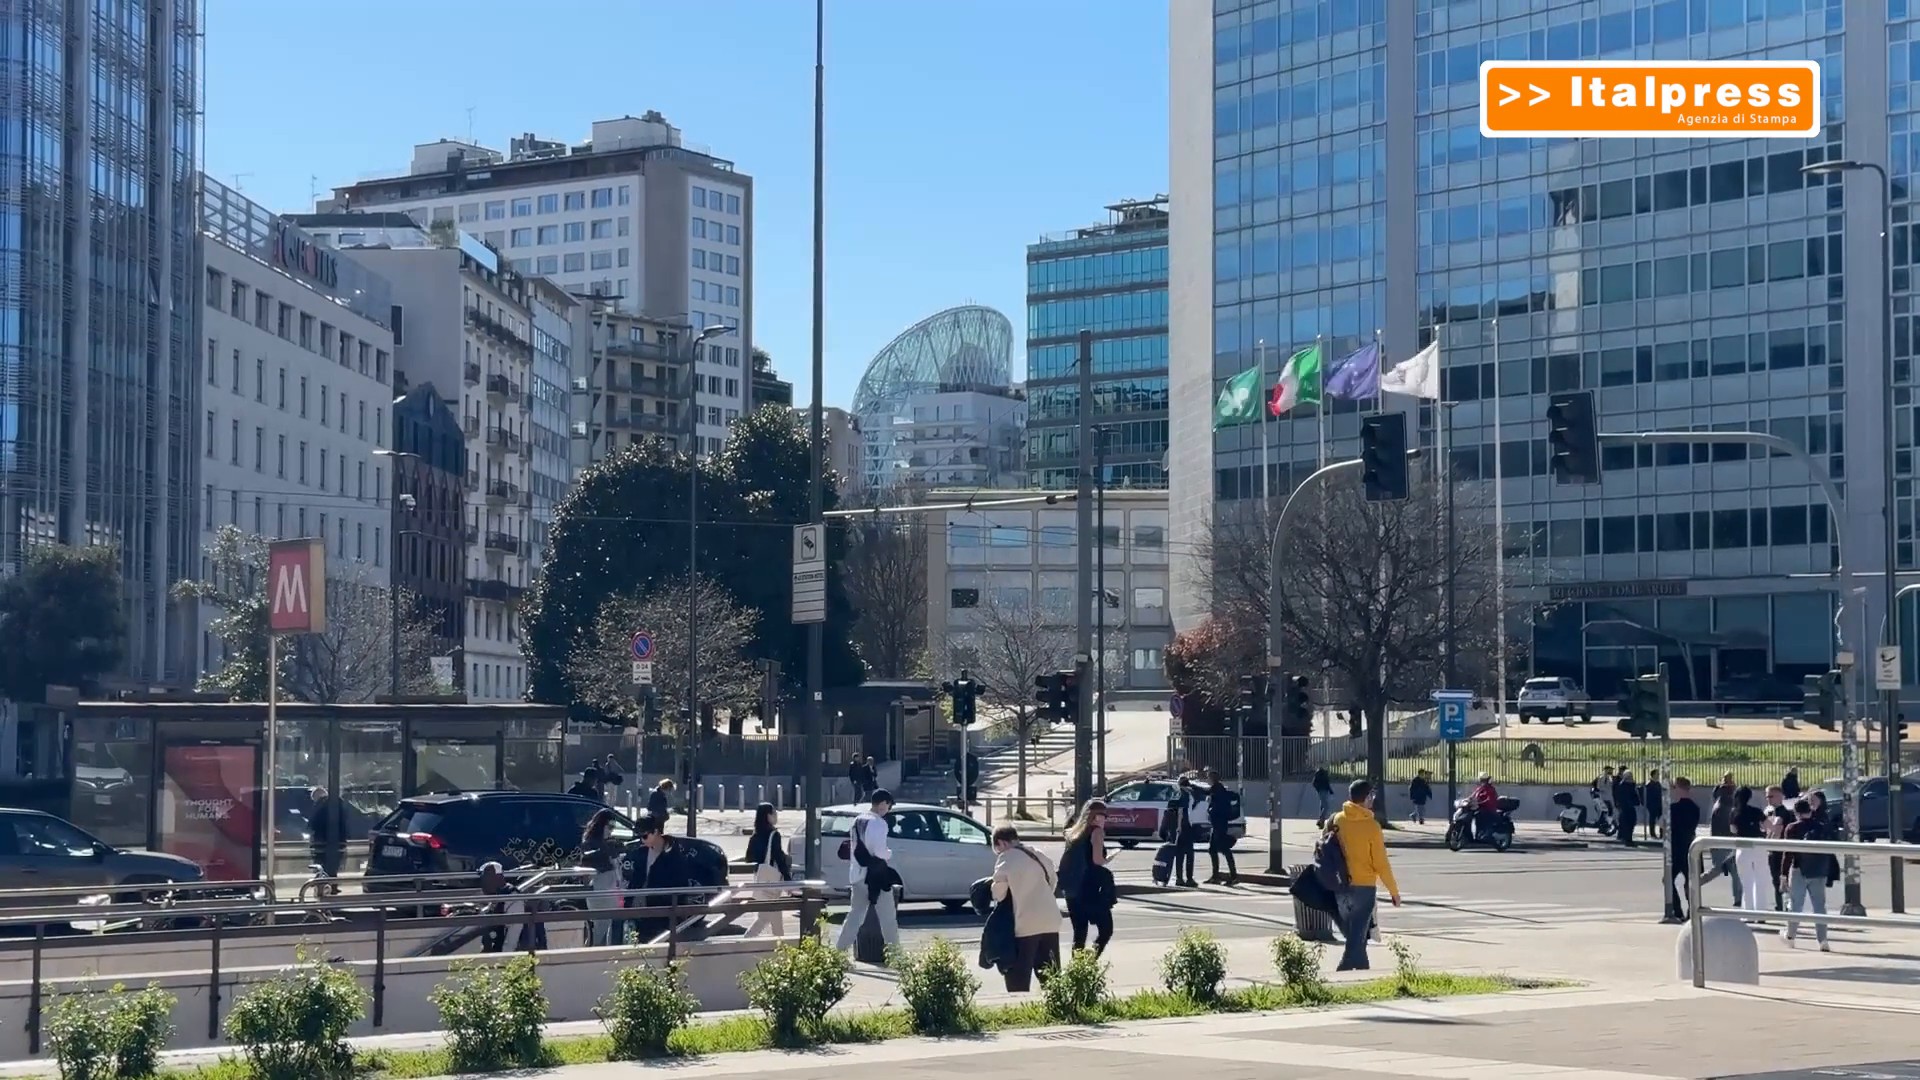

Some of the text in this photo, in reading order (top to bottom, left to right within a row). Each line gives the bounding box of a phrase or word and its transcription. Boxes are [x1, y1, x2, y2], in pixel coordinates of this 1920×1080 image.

[273, 563, 307, 614] M
[1445, 703, 1459, 721] P
[184, 798, 233, 807] THOUGHT
